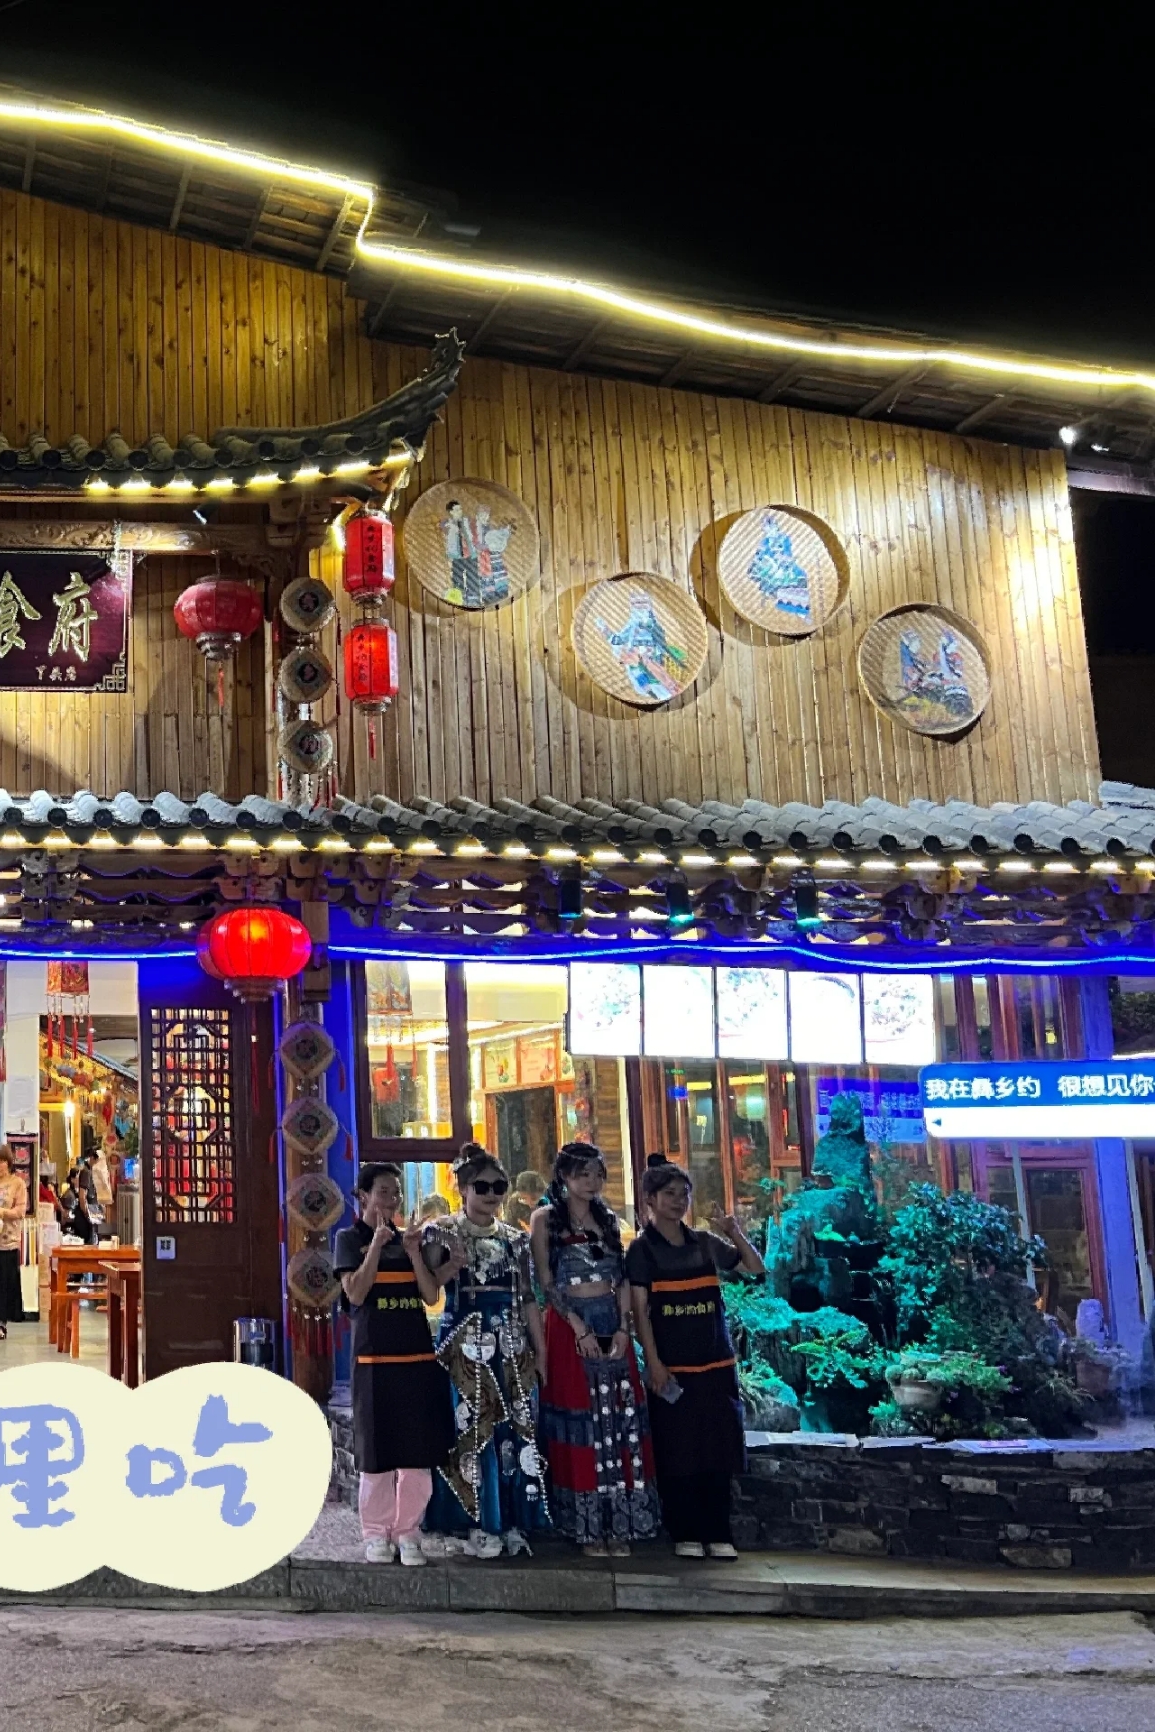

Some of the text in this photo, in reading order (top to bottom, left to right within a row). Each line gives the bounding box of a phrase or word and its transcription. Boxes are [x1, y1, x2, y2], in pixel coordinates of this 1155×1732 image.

[925, 1074, 1155, 1100] 我在彝乡约 很想见你
